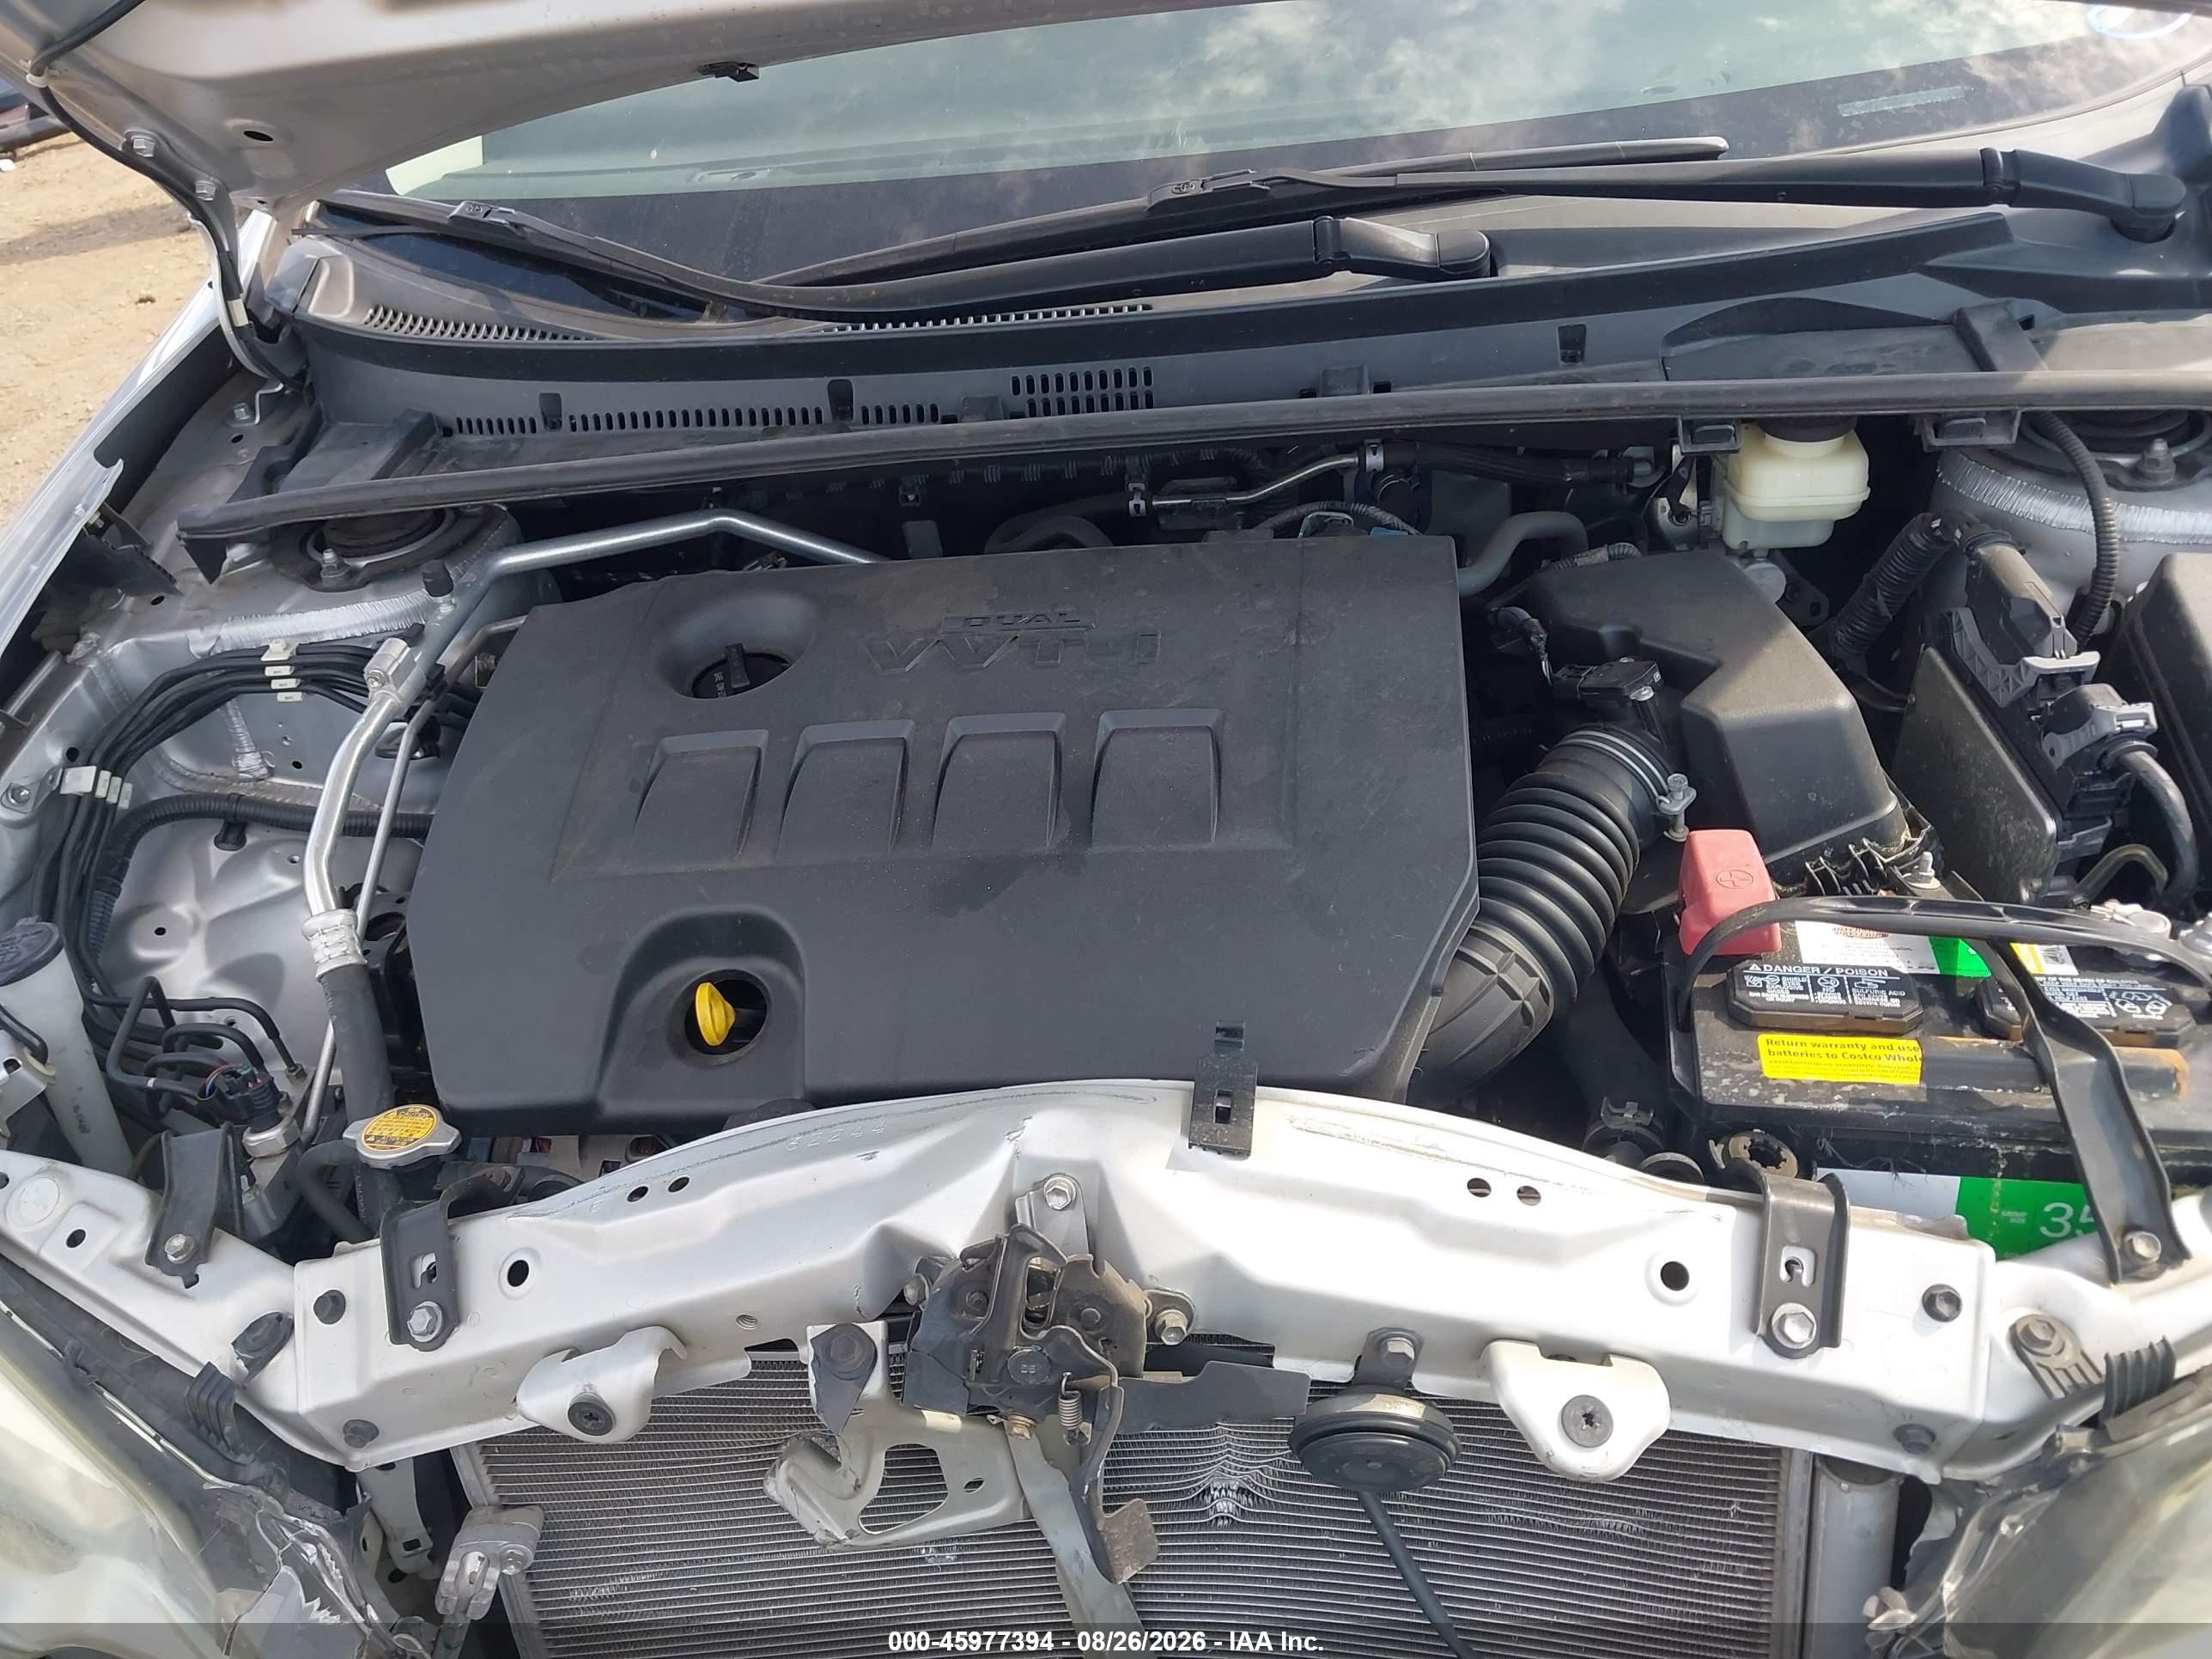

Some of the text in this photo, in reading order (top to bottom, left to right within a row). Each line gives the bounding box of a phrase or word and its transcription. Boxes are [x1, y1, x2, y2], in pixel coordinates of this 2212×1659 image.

[964, 612, 1080, 627] DUAL
[1763, 964, 1820, 974] DANGER
[1836, 967, 1888, 976] POISON
[1765, 1038, 1807, 1048] Return
[1811, 1041, 1867, 1052] warranty
[1870, 1042, 1894, 1051] and
[1768, 1048, 1822, 1059] batteries
[1826, 1051, 1838, 1060] to
[1841, 1051, 1881, 1061] Costco
